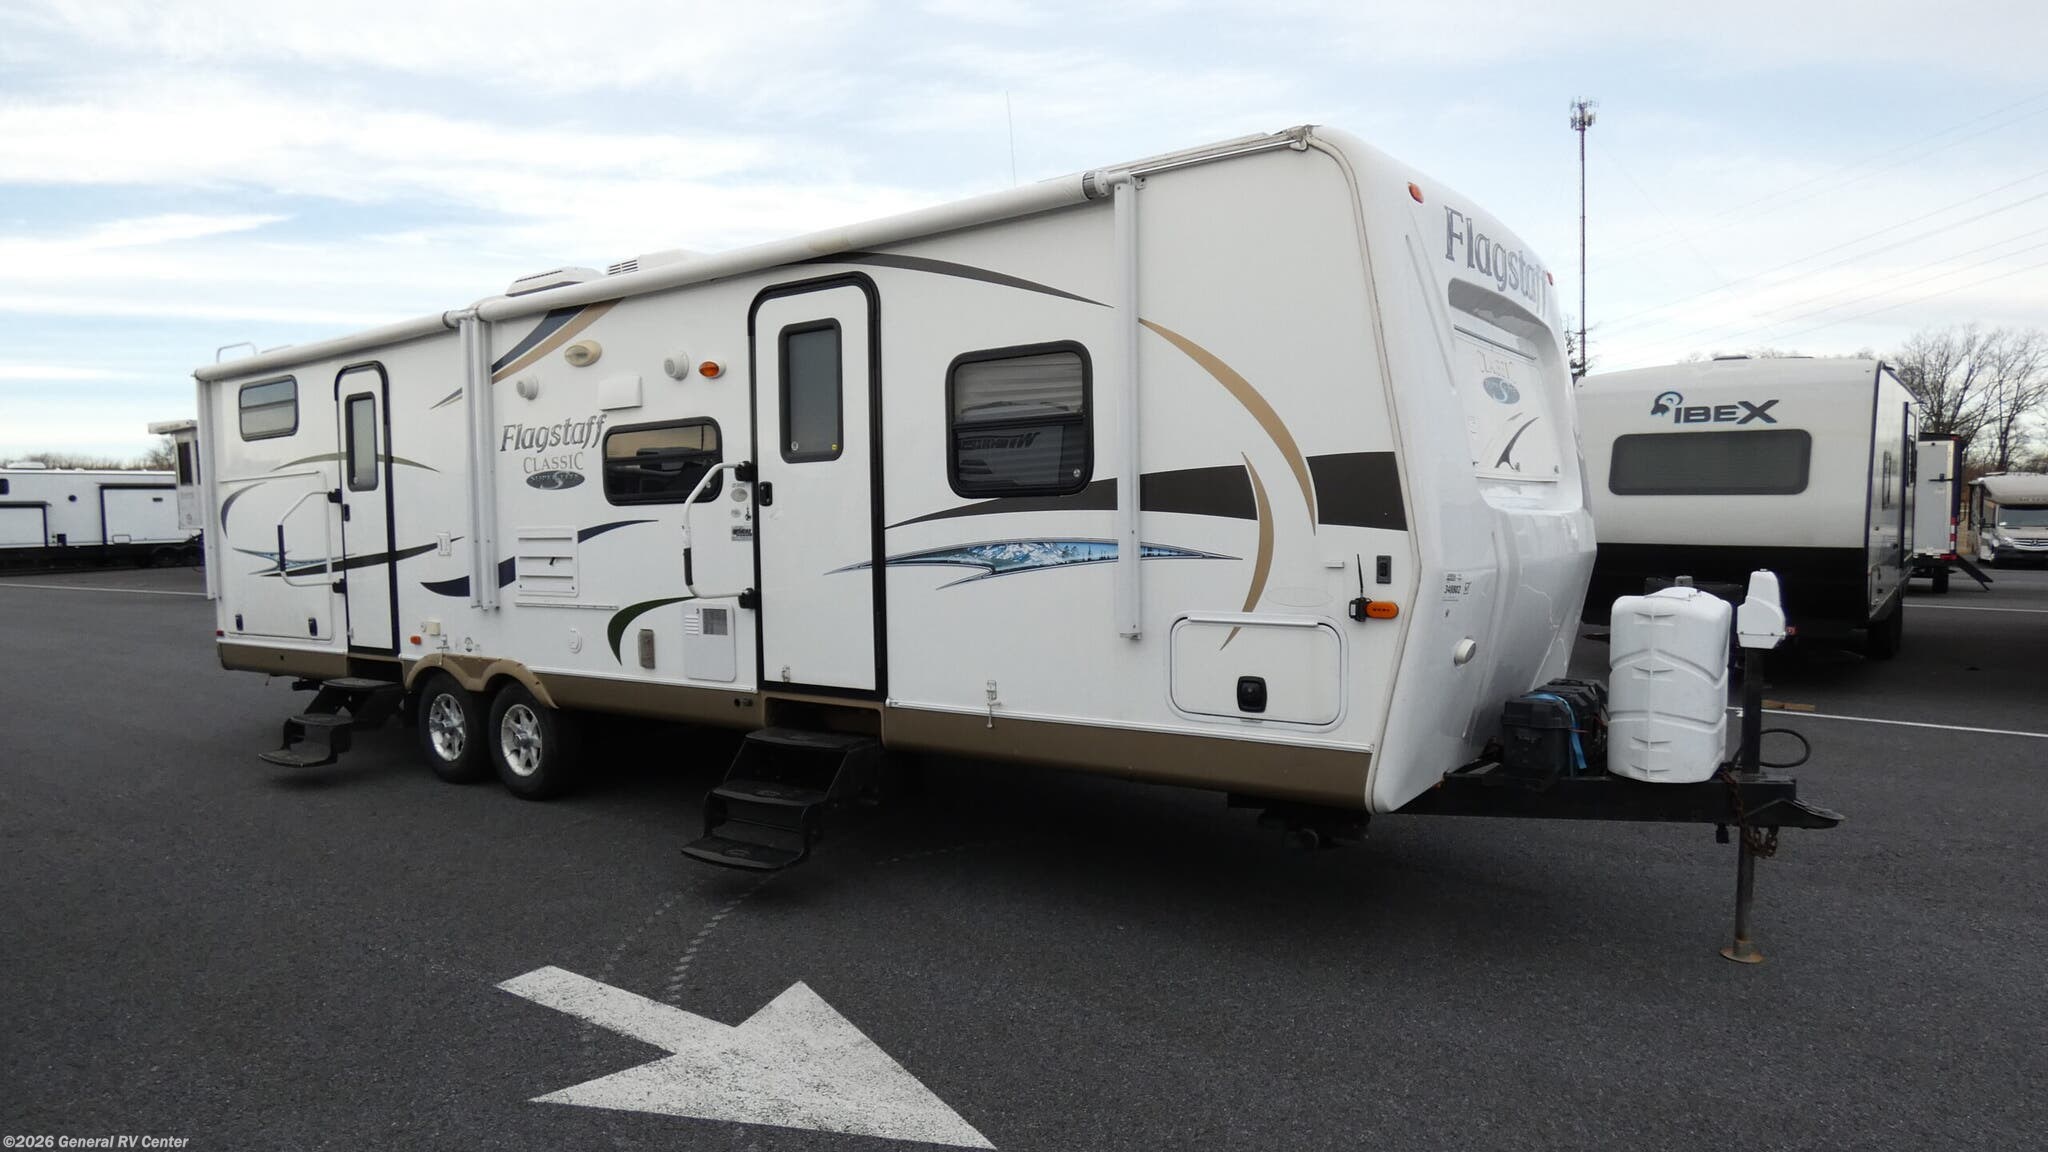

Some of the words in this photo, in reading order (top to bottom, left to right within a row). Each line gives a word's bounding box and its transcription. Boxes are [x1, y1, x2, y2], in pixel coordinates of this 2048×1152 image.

[1444, 205, 1547, 318] Flagstaff
[1674, 399, 1779, 424] IBEX
[500, 414, 607, 453] Flagstaff
[523, 452, 584, 474] CLASSIC
